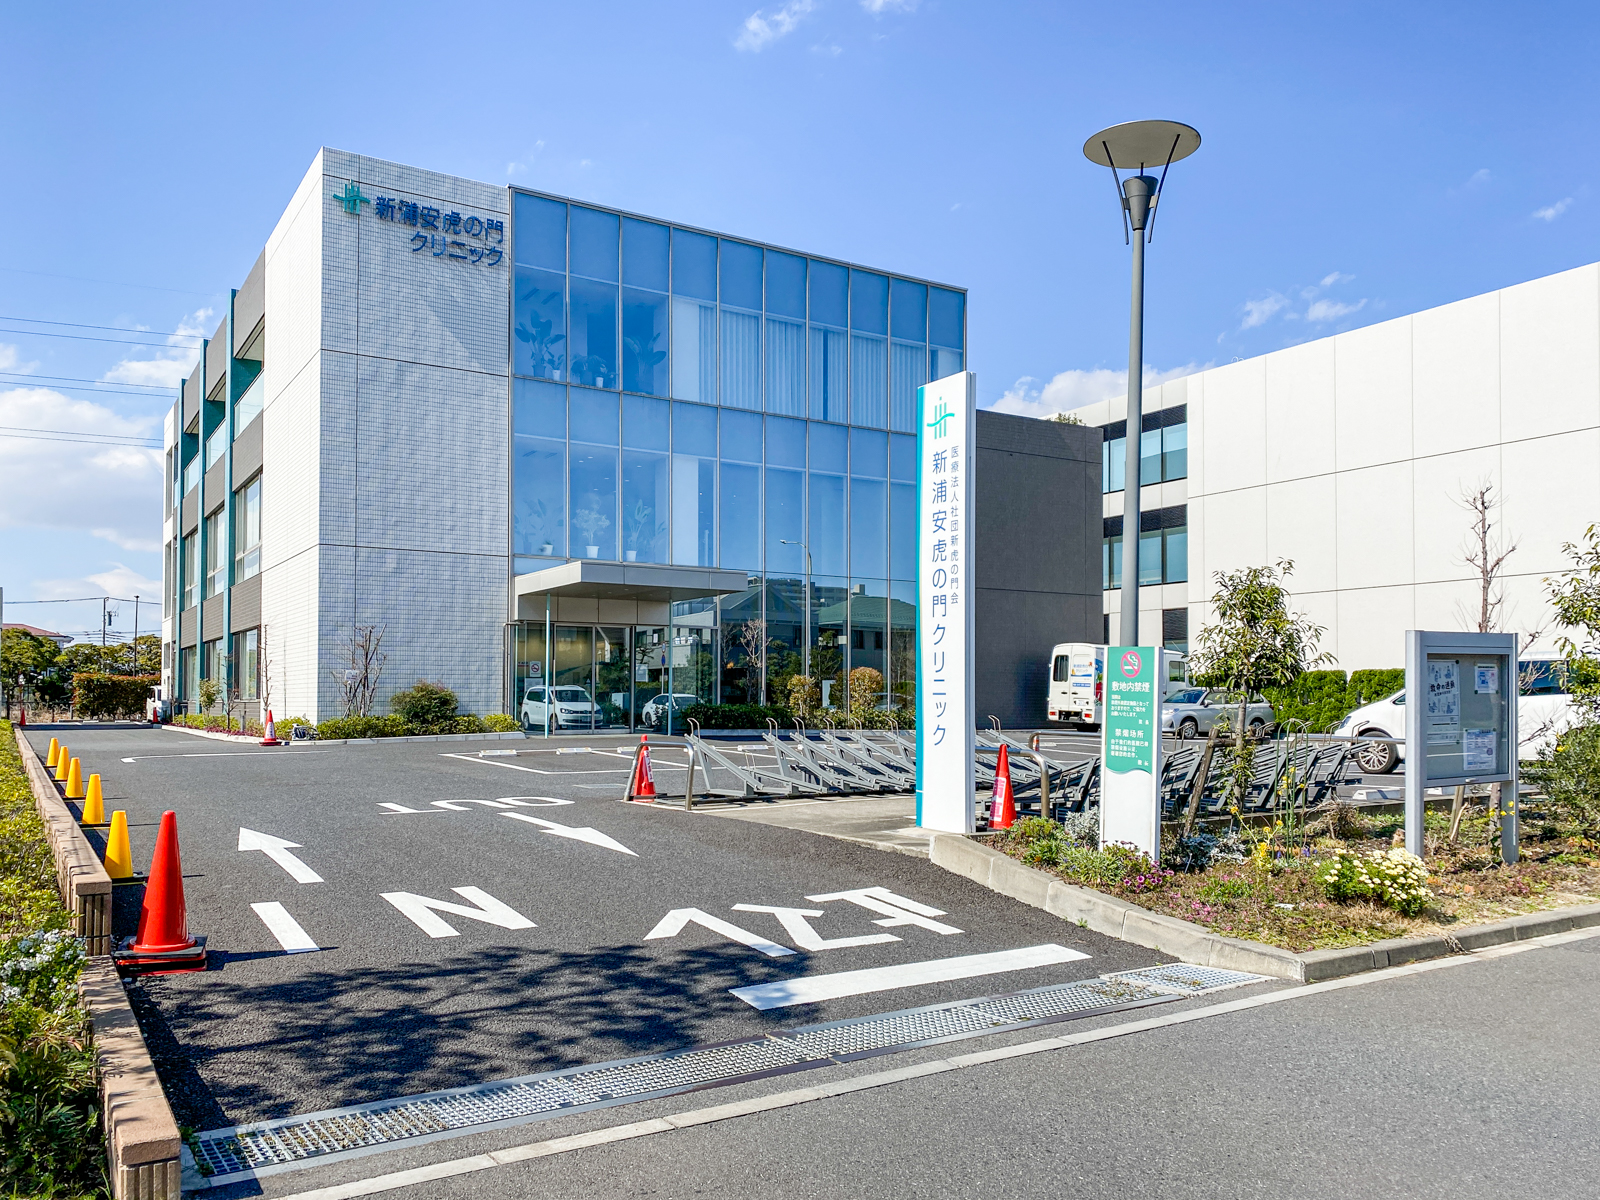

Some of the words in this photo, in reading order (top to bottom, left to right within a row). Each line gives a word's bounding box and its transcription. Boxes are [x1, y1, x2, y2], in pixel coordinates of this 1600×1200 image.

[375, 194, 504, 244] 新浦安虎の門
[410, 230, 504, 267] クリニック
[950, 445, 960, 605] 医療法人社団新虎の門会
[932, 448, 948, 746] 新浦安虎の門クリニック
[1111, 681, 1151, 693] 敷地内禁煙
[376, 796, 575, 815] OUT
[250, 886, 539, 954] IN
